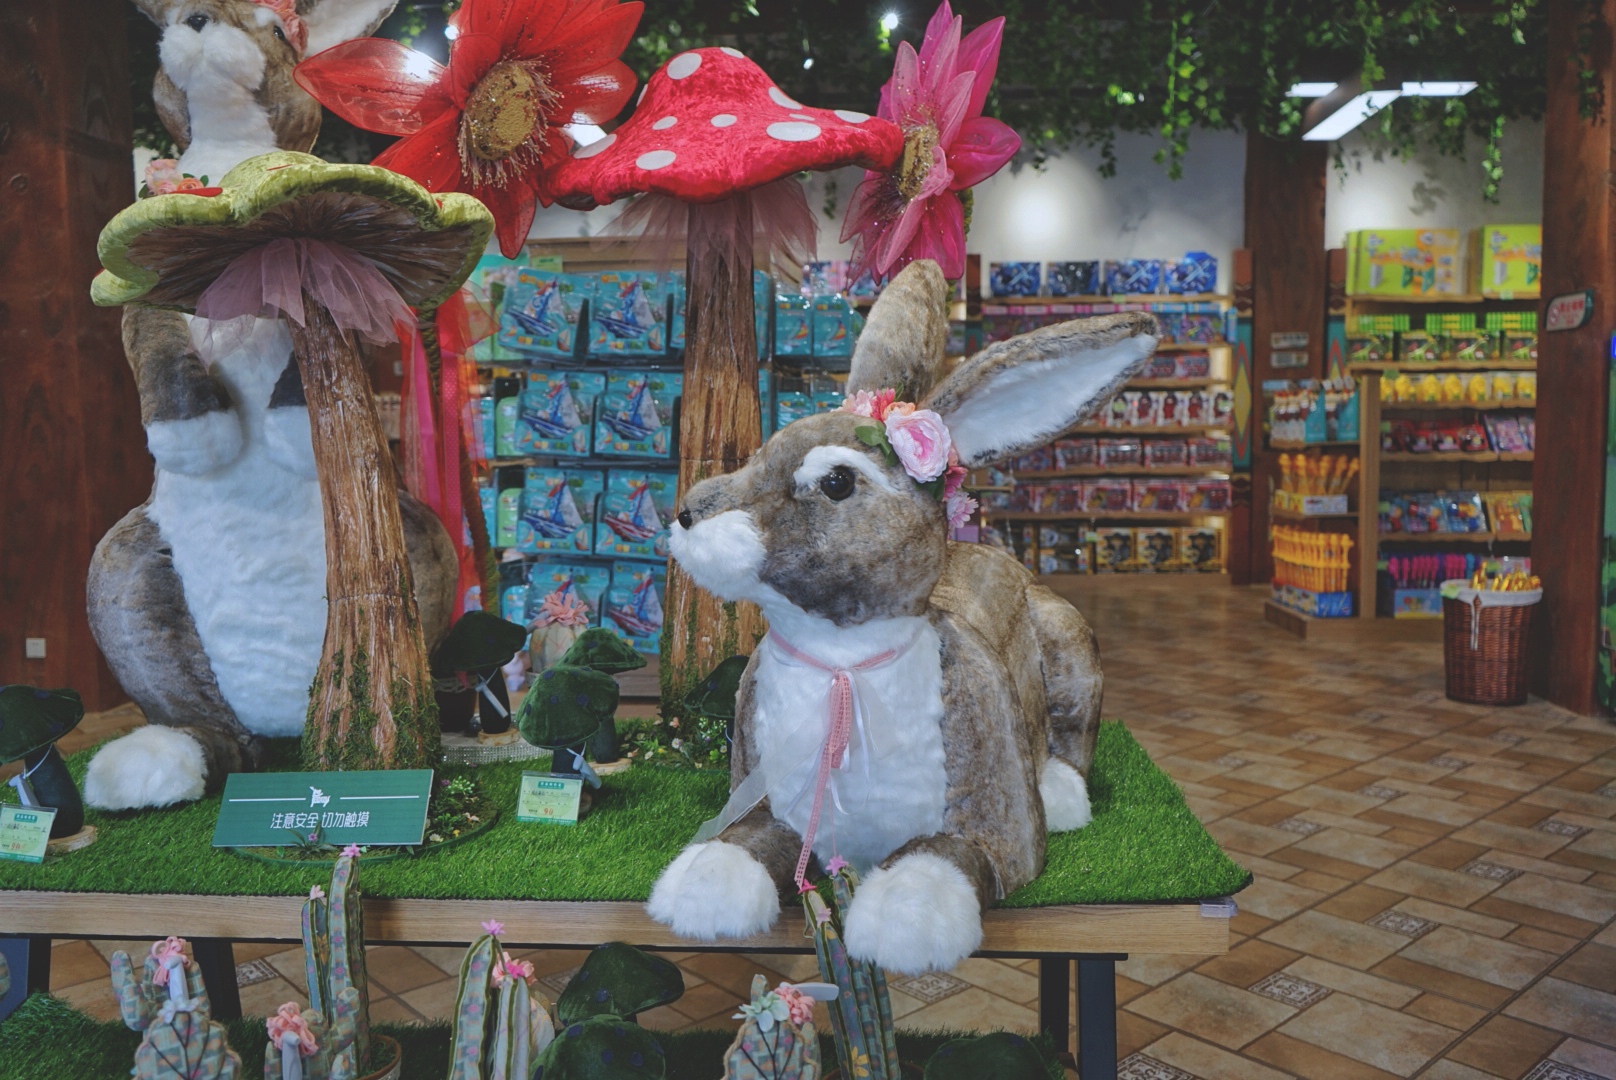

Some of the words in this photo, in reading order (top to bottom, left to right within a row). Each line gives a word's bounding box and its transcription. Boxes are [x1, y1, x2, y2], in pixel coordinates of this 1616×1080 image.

[270, 812, 318, 828] 注意安全
[321, 811, 370, 827] 切勿触摸
